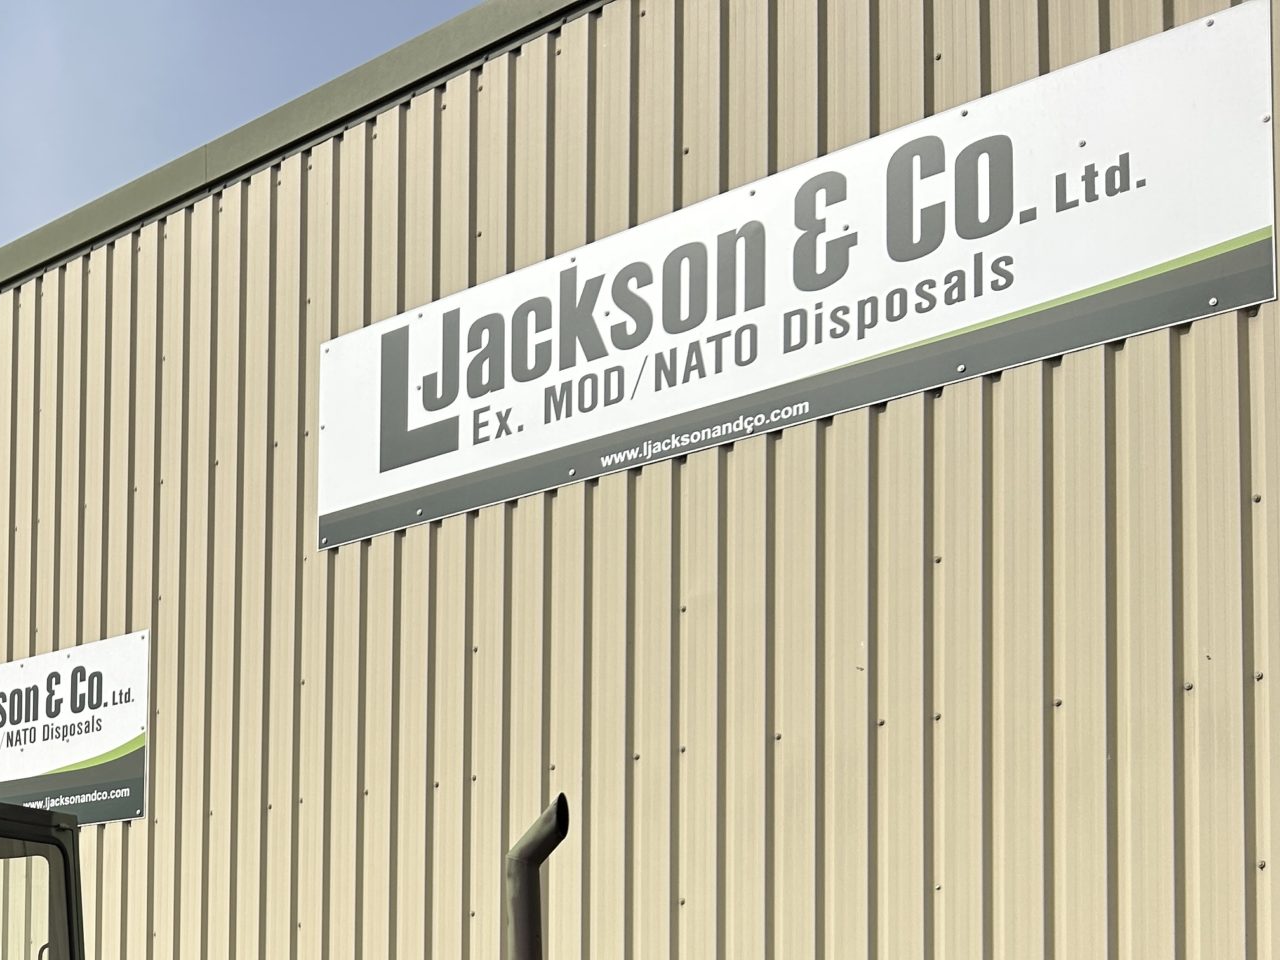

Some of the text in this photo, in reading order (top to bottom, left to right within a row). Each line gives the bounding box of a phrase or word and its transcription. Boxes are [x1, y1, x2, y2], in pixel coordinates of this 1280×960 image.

[792, 170, 858, 293] &
[886, 134, 1038, 263] Co.
[1055, 151, 1148, 214] Ltd.
[472, 251, 1015, 446] Ex. MOD/NATO Disposals
[600, 400, 810, 468] www.ljacksonandco.com
[45, 671, 64, 719] &
[70, 665, 109, 714] Co.
[111, 687, 135, 706] Ltd.
[42, 714, 103, 742] Disposals
